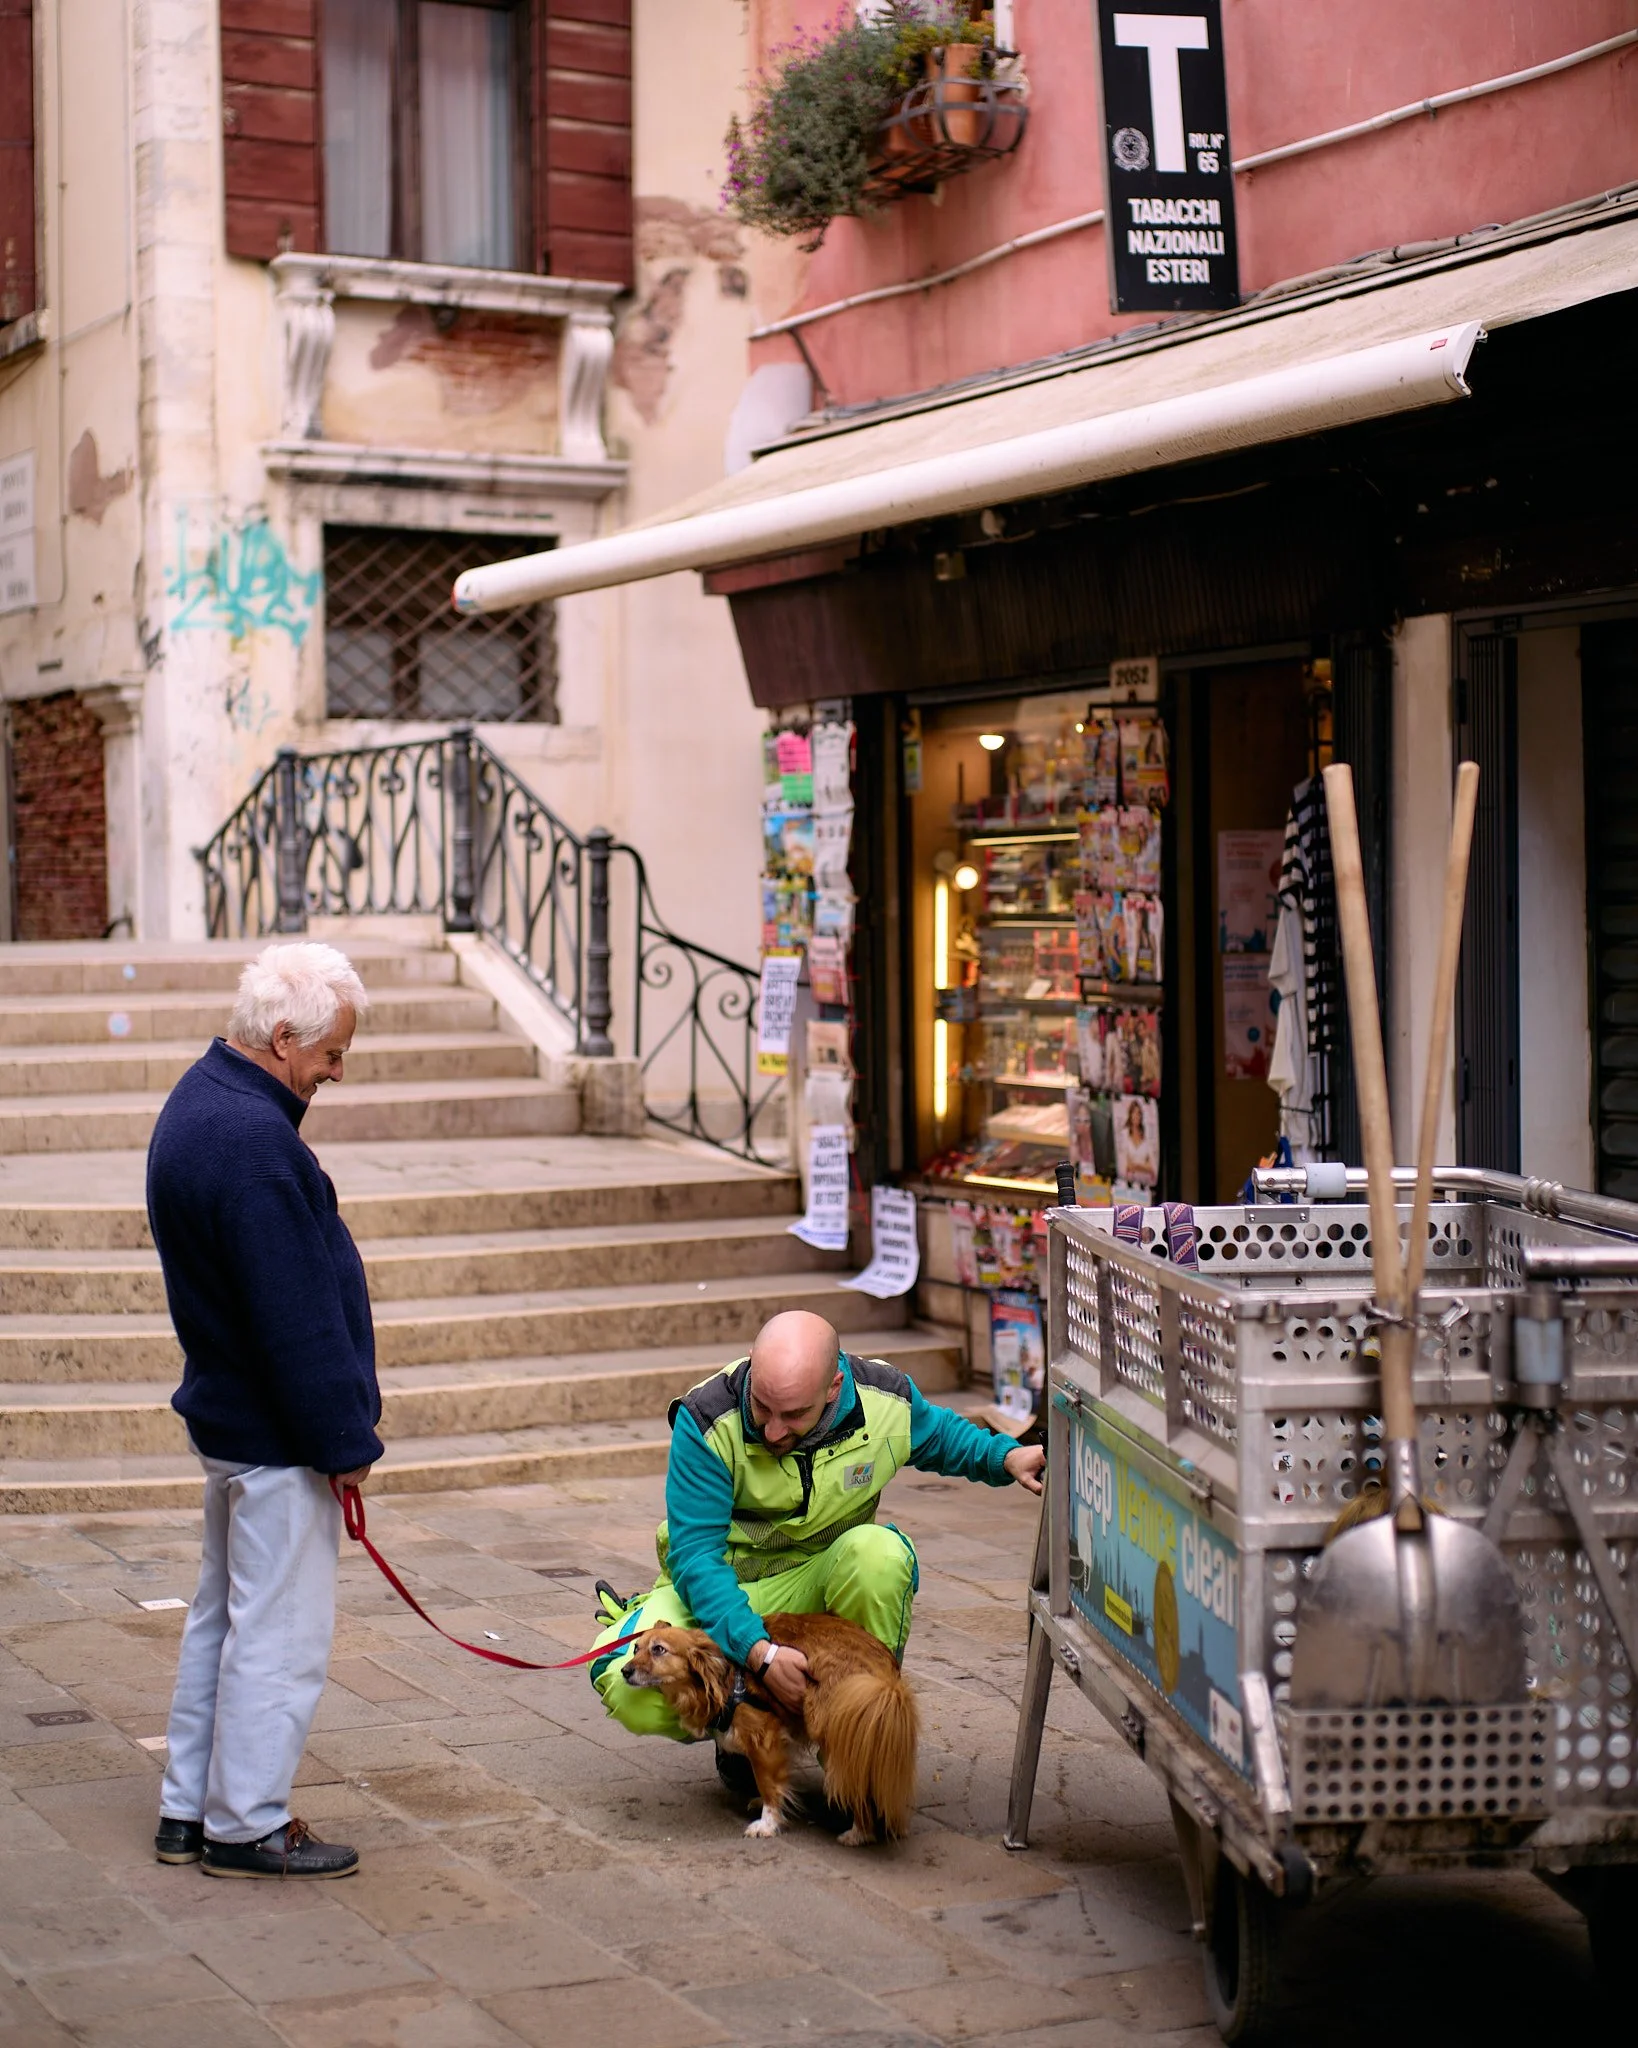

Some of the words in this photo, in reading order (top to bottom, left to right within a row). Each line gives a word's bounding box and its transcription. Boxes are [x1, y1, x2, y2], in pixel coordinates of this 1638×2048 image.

[1113, 13, 1209, 173] T
[1197, 151, 1220, 173] 65
[1127, 198, 1221, 225] TABACCHI
[1127, 230, 1225, 255] NAZIONALI
[1146, 259, 1210, 284] ESTERI
[1075, 1422, 1112, 1538] Keep
[1116, 1456, 1177, 1577] Venice
